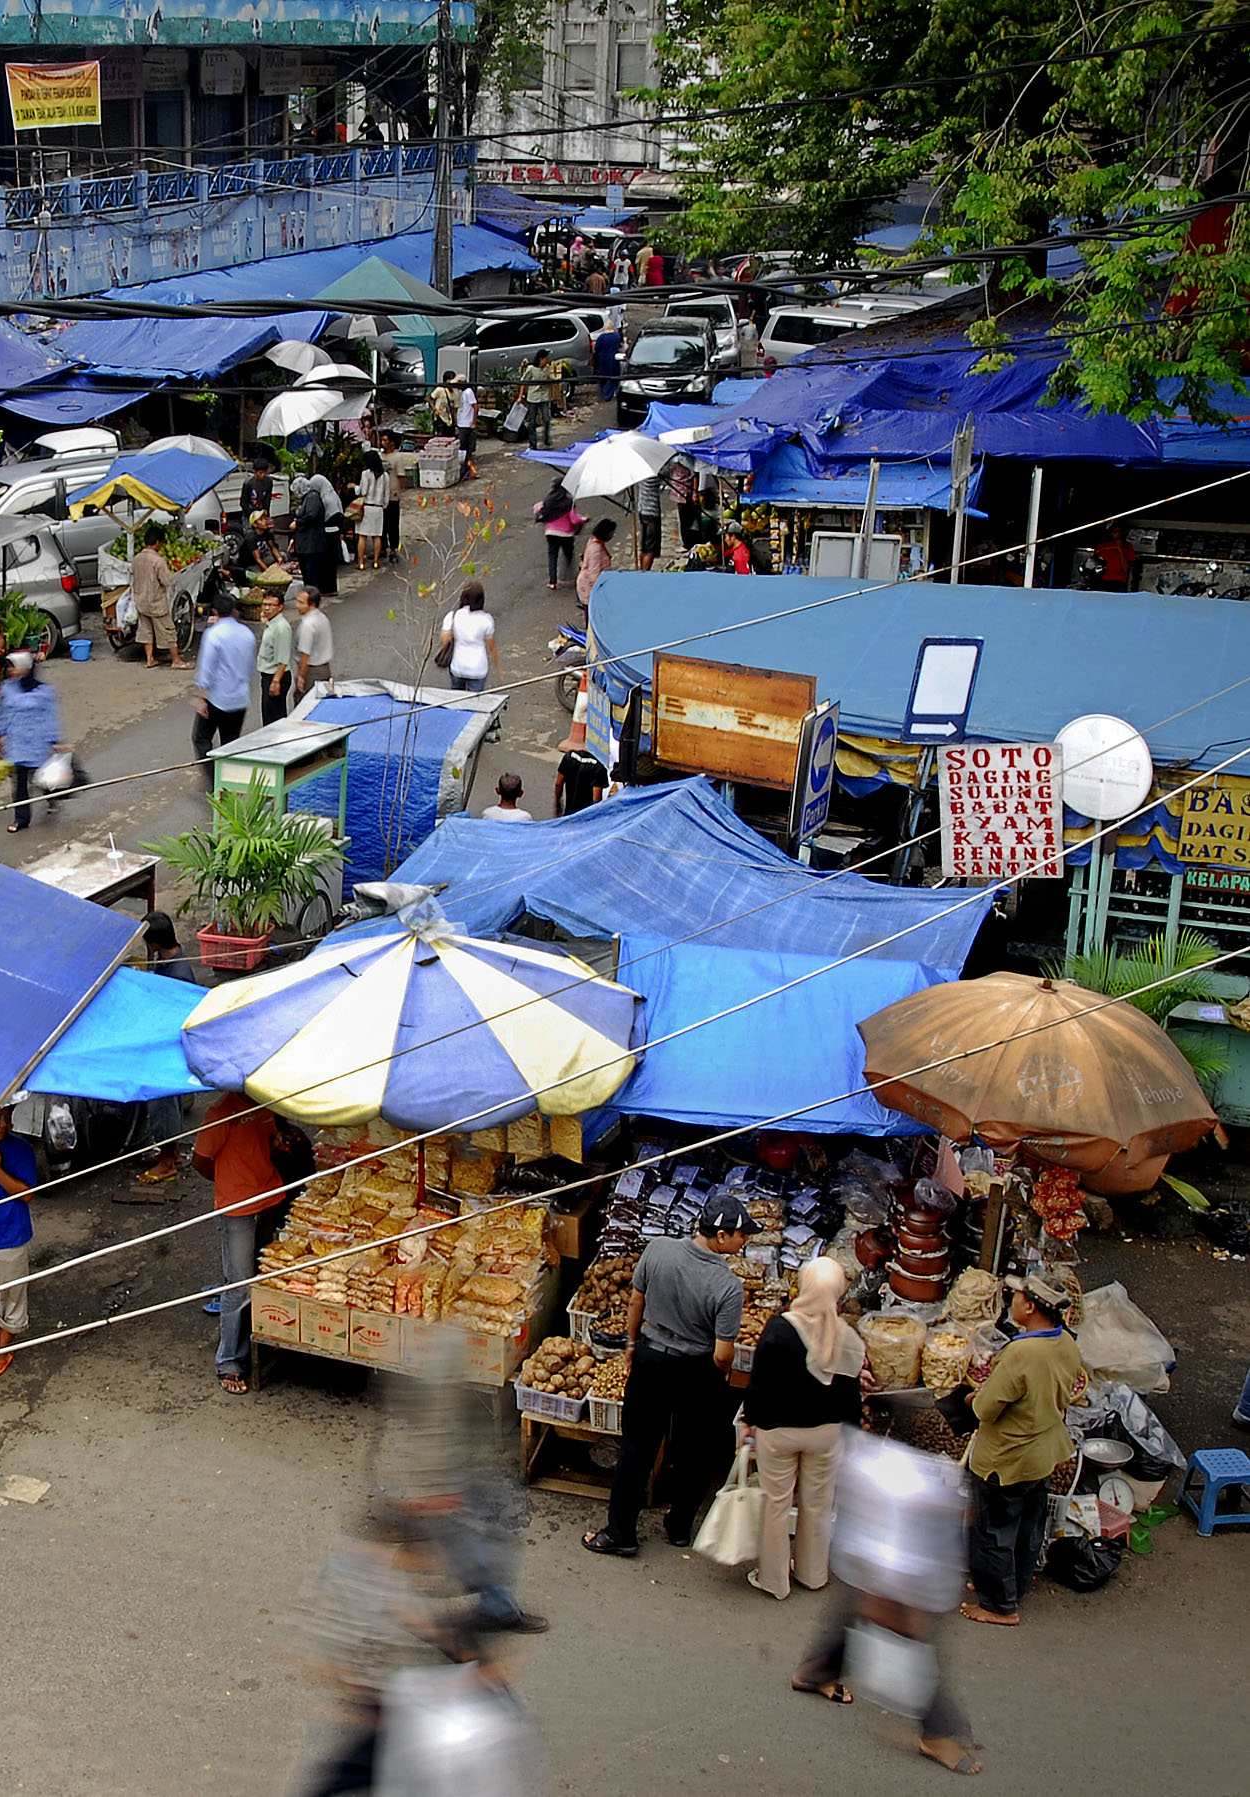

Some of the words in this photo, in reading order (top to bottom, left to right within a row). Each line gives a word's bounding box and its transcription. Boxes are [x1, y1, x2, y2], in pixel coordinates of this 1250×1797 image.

[945, 747, 1053, 771] SOTO
[948, 769, 1051, 785] DAGING
[950, 785, 1052, 800] SULUNG
[950, 800, 1053, 815] BABAT
[952, 816, 1053, 831] AYAM
[953, 831, 1055, 846] KAKI
[953, 846, 1057, 861] BENING
[1179, 842, 1227, 860] RAT
[953, 861, 1058, 877] SANTAN
[1186, 870, 1250, 892] KELAPA
